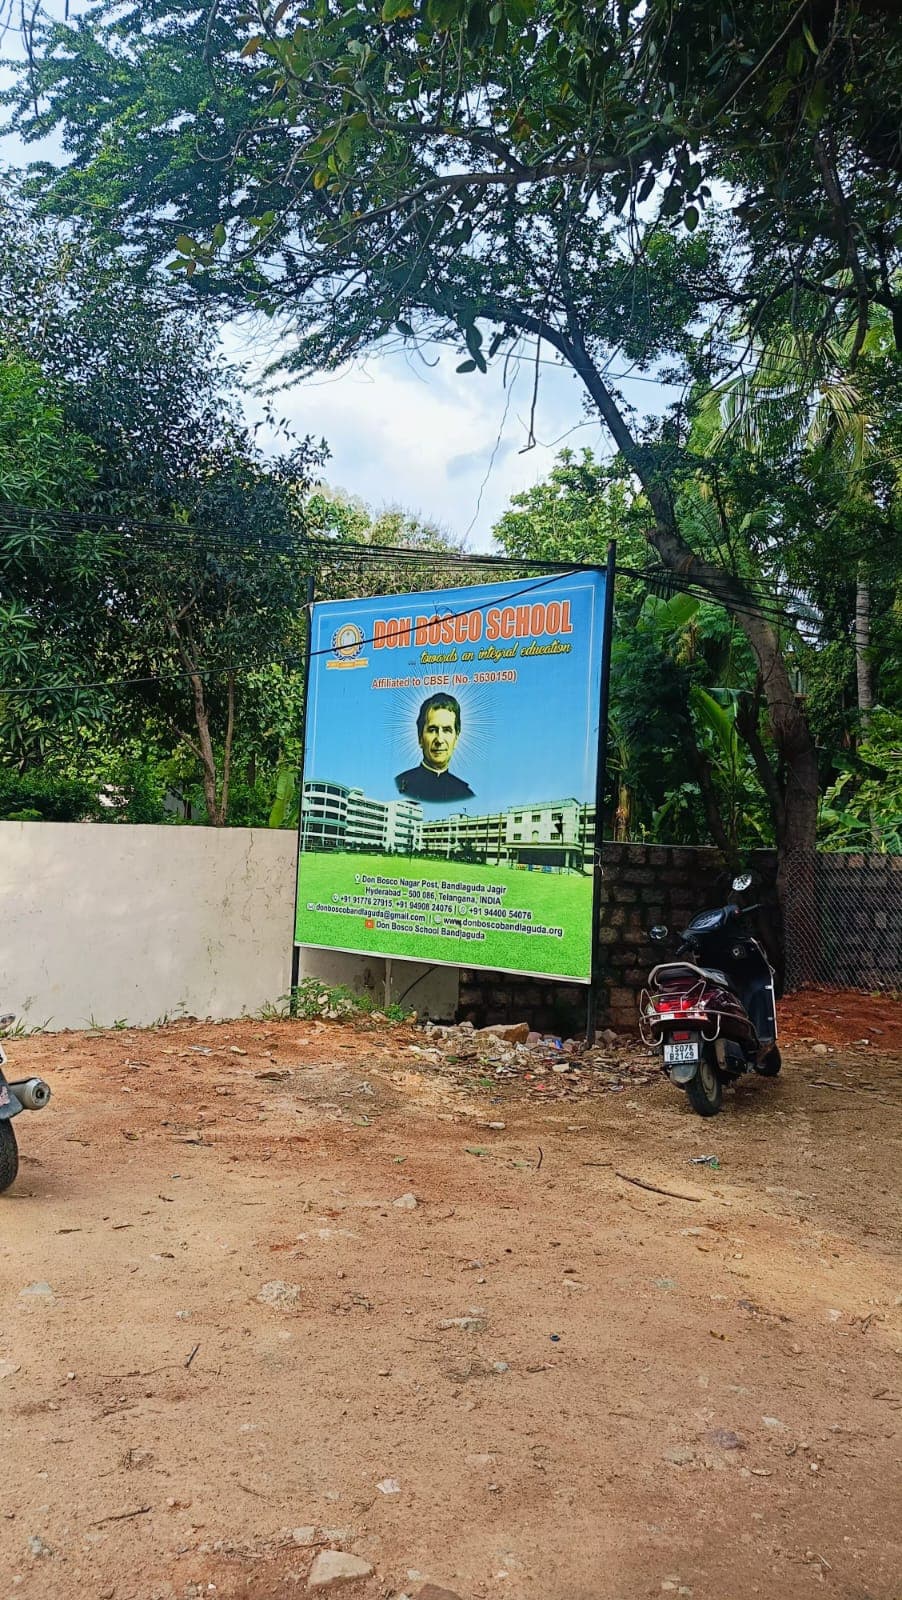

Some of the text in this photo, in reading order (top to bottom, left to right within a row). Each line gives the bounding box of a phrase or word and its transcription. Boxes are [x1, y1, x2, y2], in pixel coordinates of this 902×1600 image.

[373, 599, 573, 650] DON BOSCO SCHOOL
[420, 647, 458, 664] towards
[461, 651, 474, 663] an
[478, 641, 519, 663] integral
[520, 640, 572, 657] education
[372, 677, 410, 689] Affiliated
[412, 677, 421, 687] to
[423, 675, 449, 686] CBSE
[473, 670, 517, 683] 3630150)
[362, 875, 506, 895] Don Bosco Nagar Post, Bandlaguda Jagir
[365, 886, 401, 897] Hyderabad
[408, 889, 421, 898] 500
[422, 891, 437, 902] 086,
[439, 892, 478, 904] Telangana,
[479, 896, 501, 905] INDIA
[316, 903, 426, 922] donboscobandlaguda@gmail.com
[340, 895, 351, 903] +91
[396, 900, 408, 909] +91
[431, 903, 453, 913] 24076
[469, 907, 482, 916] +91
[484, 908, 507, 917] 94400
[508, 910, 532, 920] 54076
[376, 921, 390, 930] Don
[391, 923, 413, 932] Bosco
[414, 925, 439, 933] School
[670, 1051, 694, 1060] B2149
